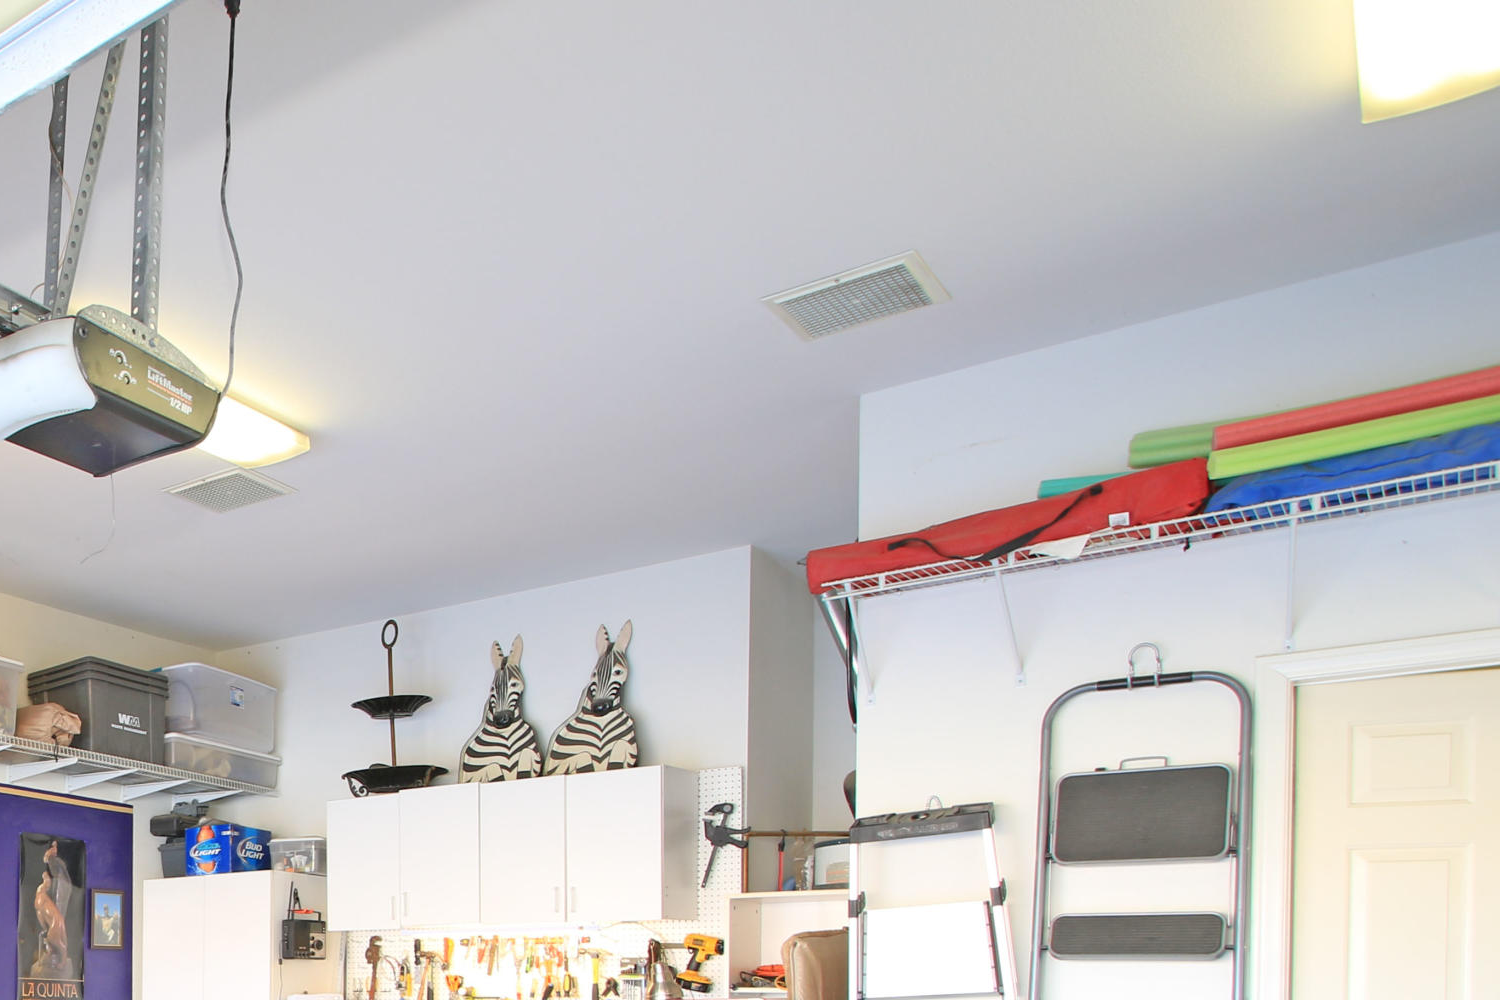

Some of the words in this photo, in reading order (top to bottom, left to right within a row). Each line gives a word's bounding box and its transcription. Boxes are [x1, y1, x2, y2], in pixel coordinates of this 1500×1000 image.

[147, 369, 193, 401] LiftMaster
[246, 841, 263, 851] BUD
[195, 848, 221, 856] LIGHT
[240, 850, 265, 860] LIGHT
[22, 982, 35, 997] LA
[37, 982, 78, 998] QUINTA
